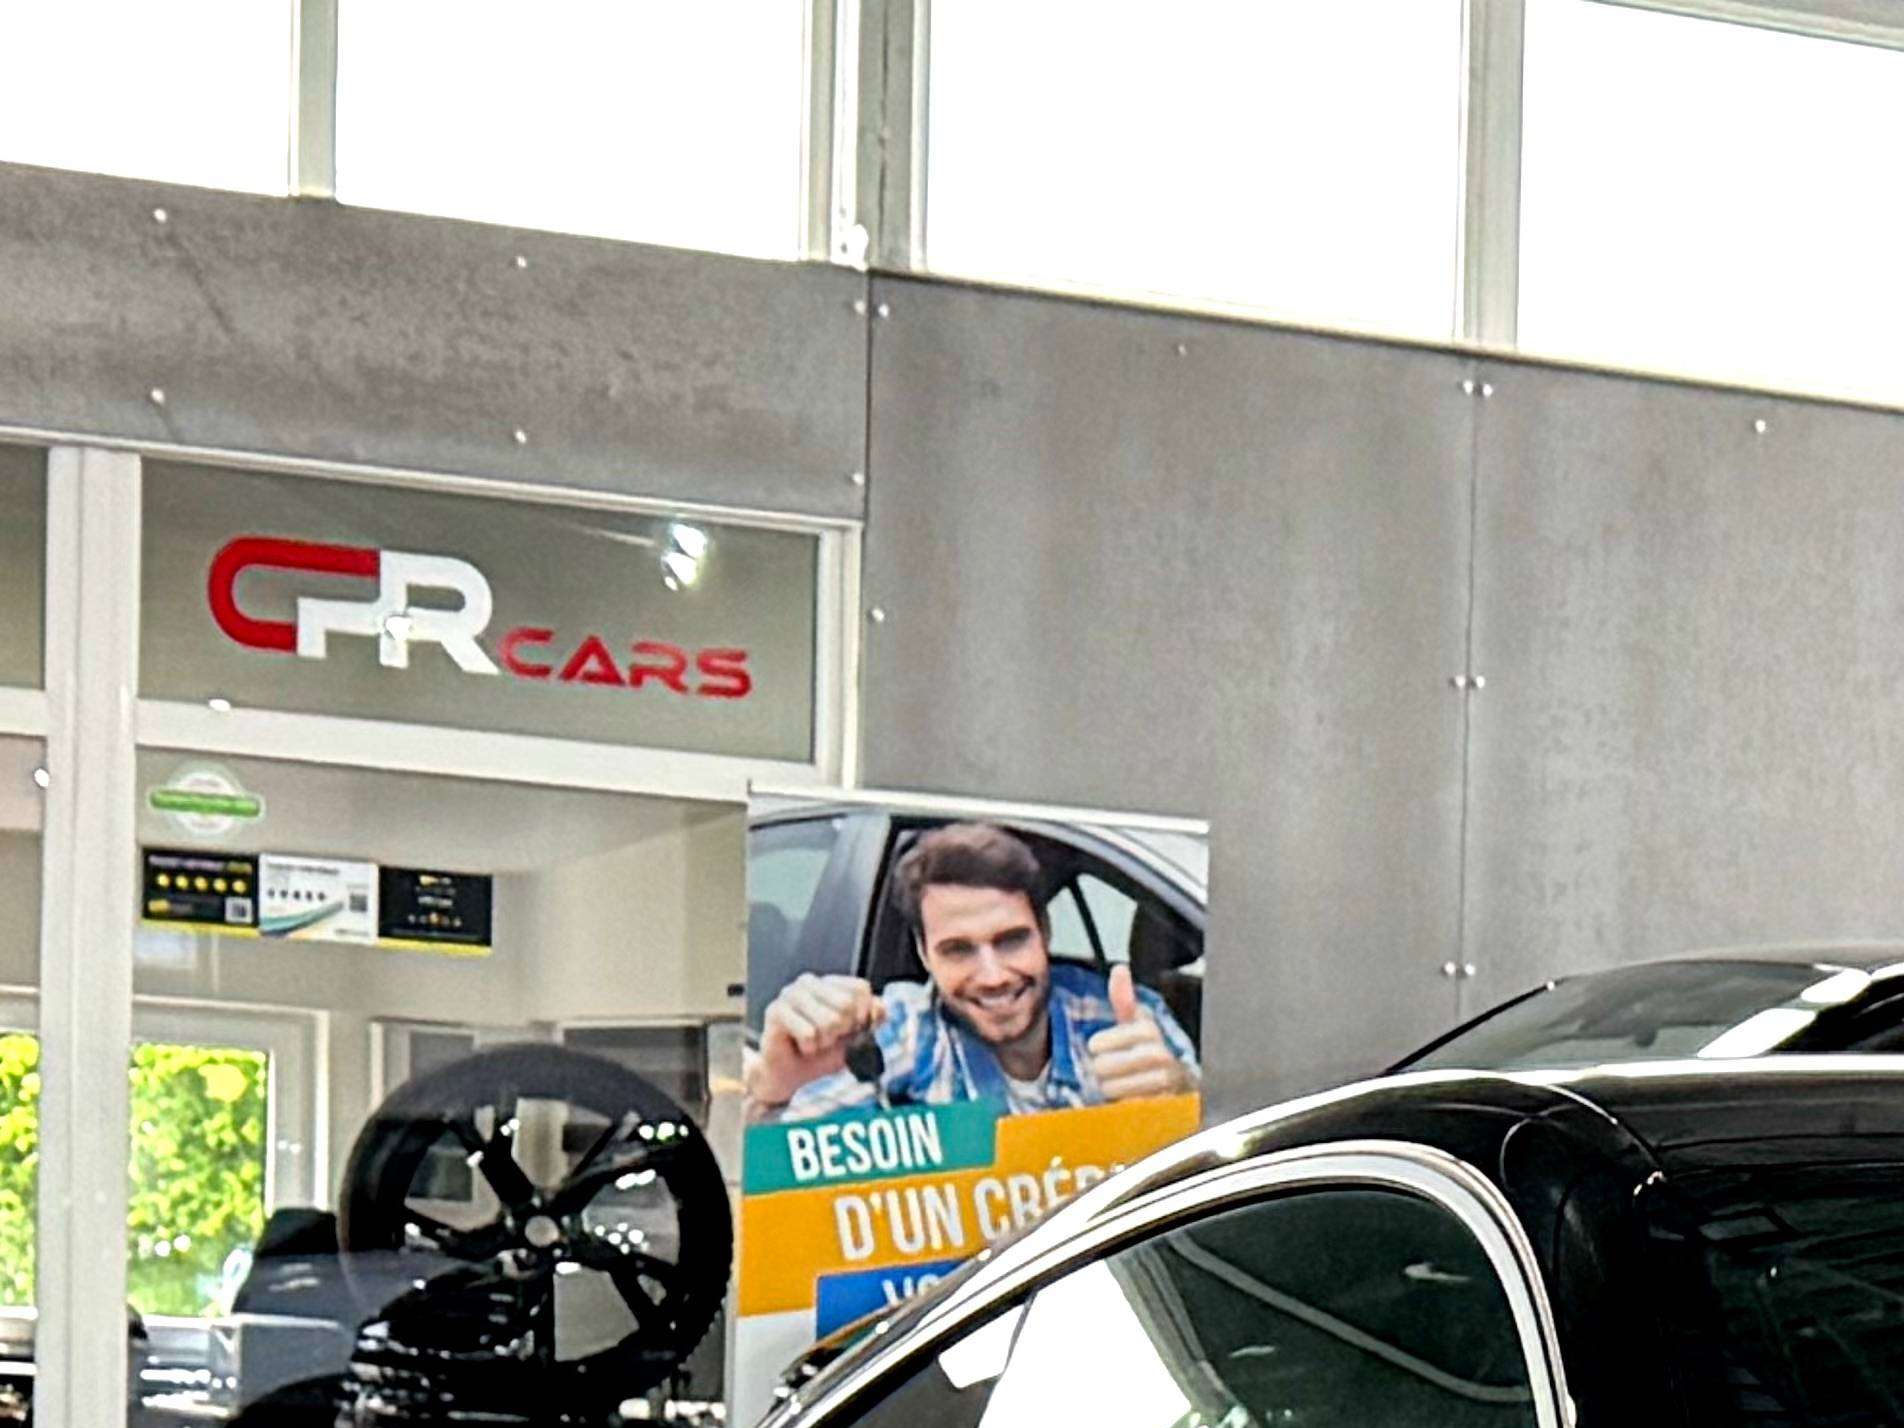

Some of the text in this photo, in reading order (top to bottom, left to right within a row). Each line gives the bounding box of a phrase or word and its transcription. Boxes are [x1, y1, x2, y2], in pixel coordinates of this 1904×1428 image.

[500, 627, 753, 700] CARS
[787, 1112, 943, 1181] BESOIN
[834, 1191, 966, 1261] D'UN
